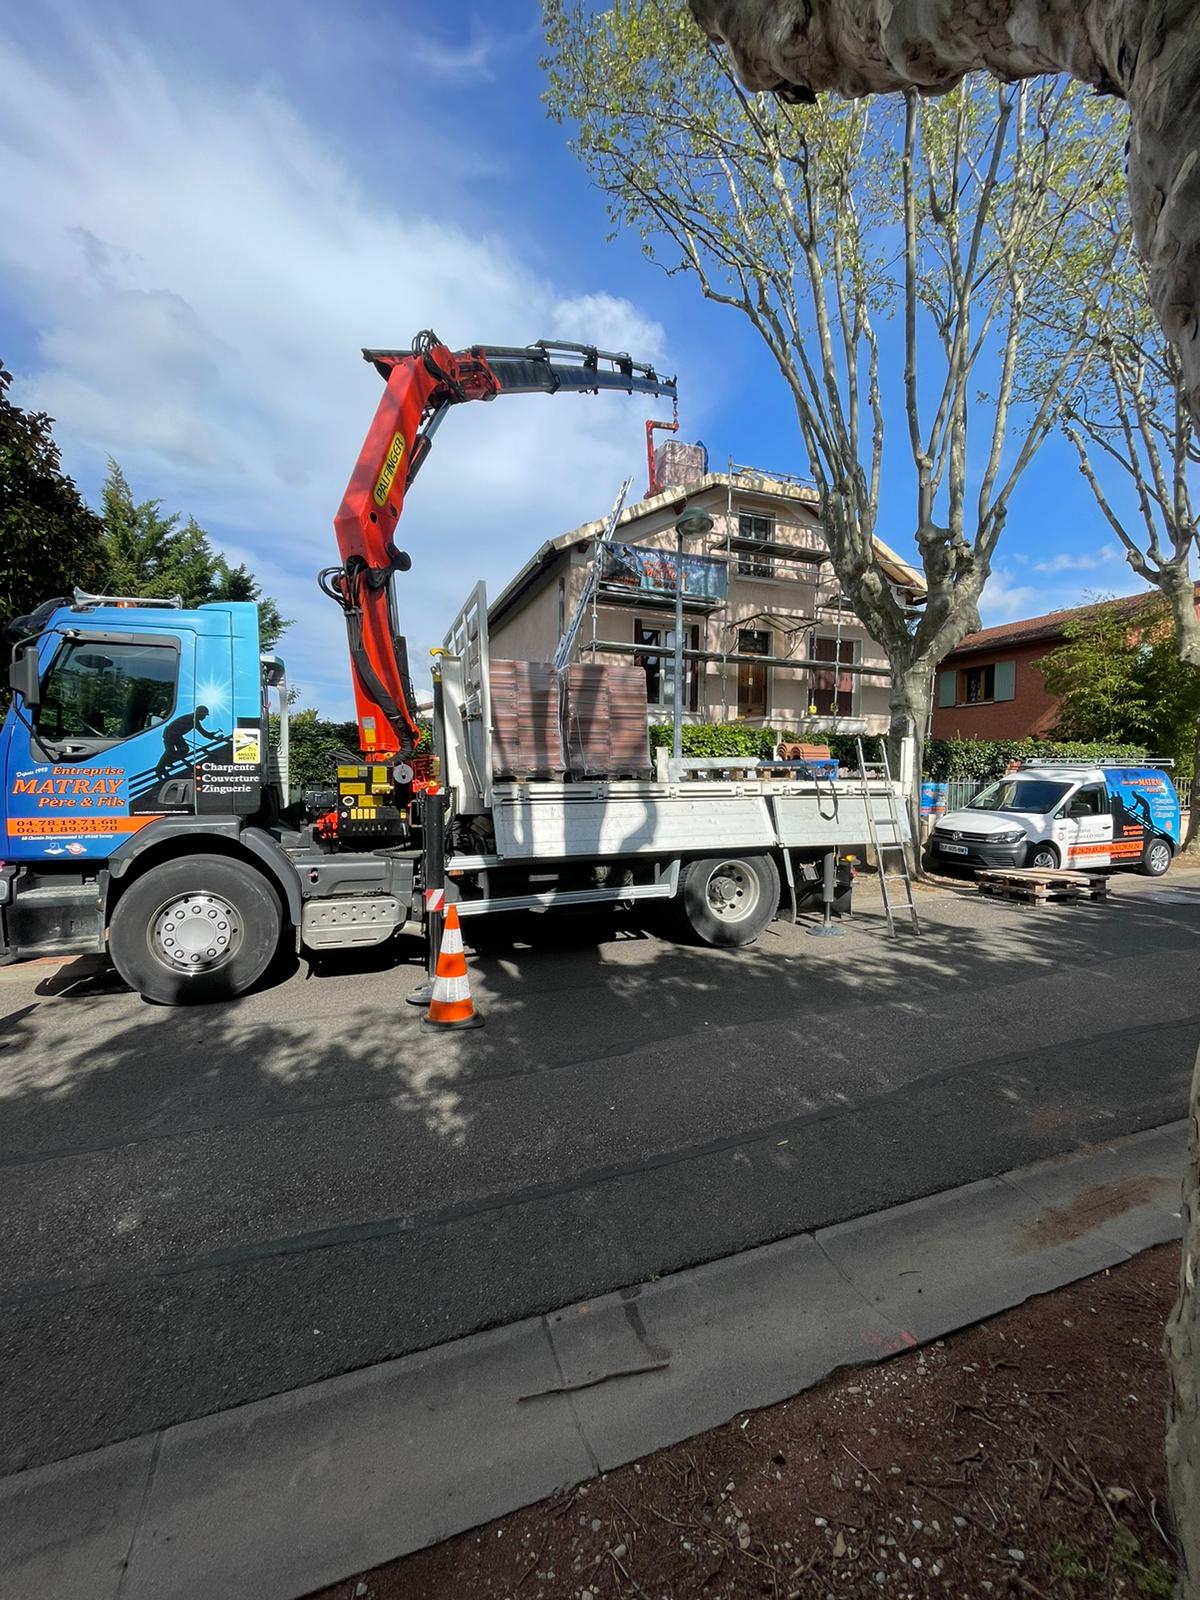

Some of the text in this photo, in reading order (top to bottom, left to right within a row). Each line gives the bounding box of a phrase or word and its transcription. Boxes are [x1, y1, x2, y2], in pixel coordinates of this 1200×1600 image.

[376, 436, 404, 501] PALFINGER
[52, 766, 125, 777] Entreprise
[201, 762, 256, 773] Charpente
[201, 773, 260, 783] Couverture
[12, 778, 124, 795] MATRAY
[201, 784, 252, 794] Zinguerie
[38, 796, 125, 808] Père & Fils
[16, 818, 118, 827] 04.78.19.71.68
[16, 825, 118, 834] 06.11.89.93.70
